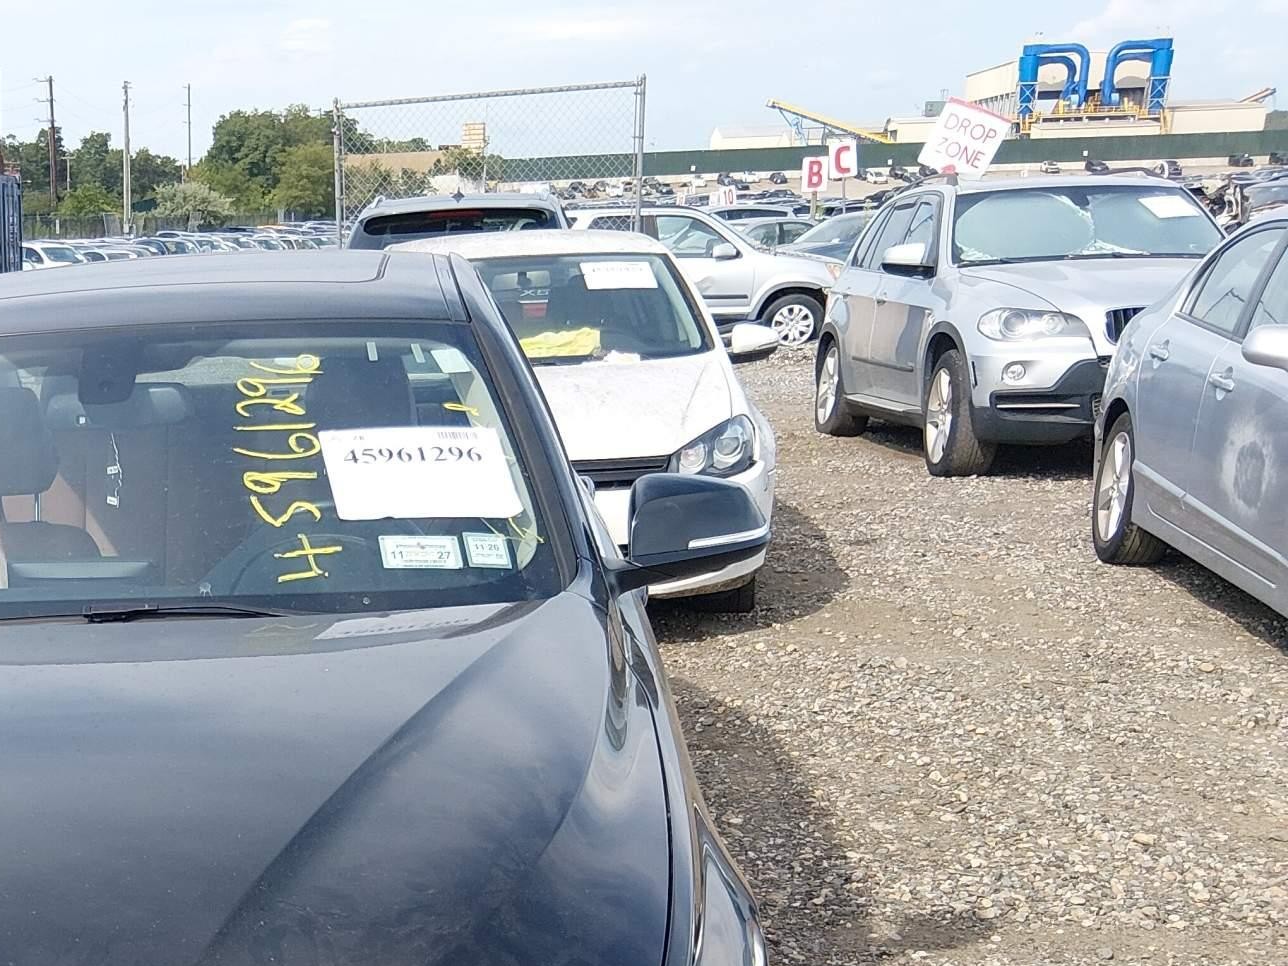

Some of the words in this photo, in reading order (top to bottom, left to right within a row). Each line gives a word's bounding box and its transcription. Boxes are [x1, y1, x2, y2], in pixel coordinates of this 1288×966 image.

[943, 112, 997, 144] DROP
[834, 145, 851, 174] C
[935, 136, 986, 169] ZONE
[808, 160, 823, 189] B
[233, 354, 343, 583] 45961296
[343, 446, 483, 464] 45961296
[391, 551, 404, 560] 11
[436, 551, 451, 560] 27
